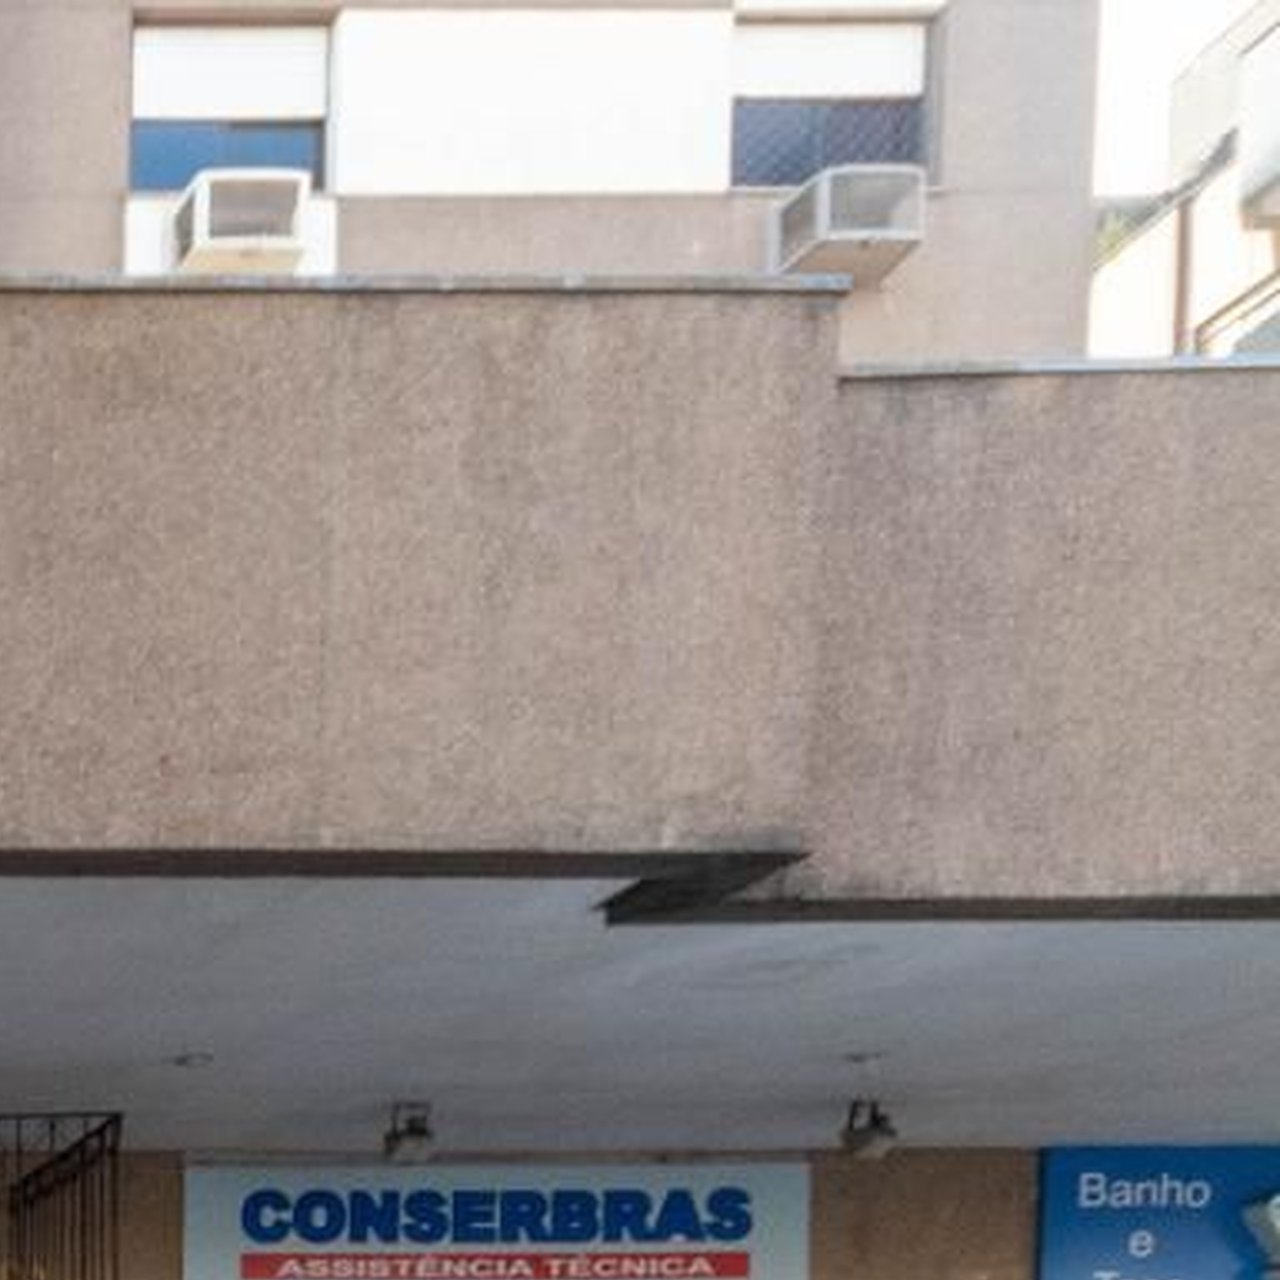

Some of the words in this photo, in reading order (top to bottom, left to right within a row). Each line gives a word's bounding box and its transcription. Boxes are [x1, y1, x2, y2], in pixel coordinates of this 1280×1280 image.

[1078, 1173, 1212, 1208] Banho
[241, 1188, 753, 1244] CONSERBRAS
[1128, 1230, 1154, 1257] e
